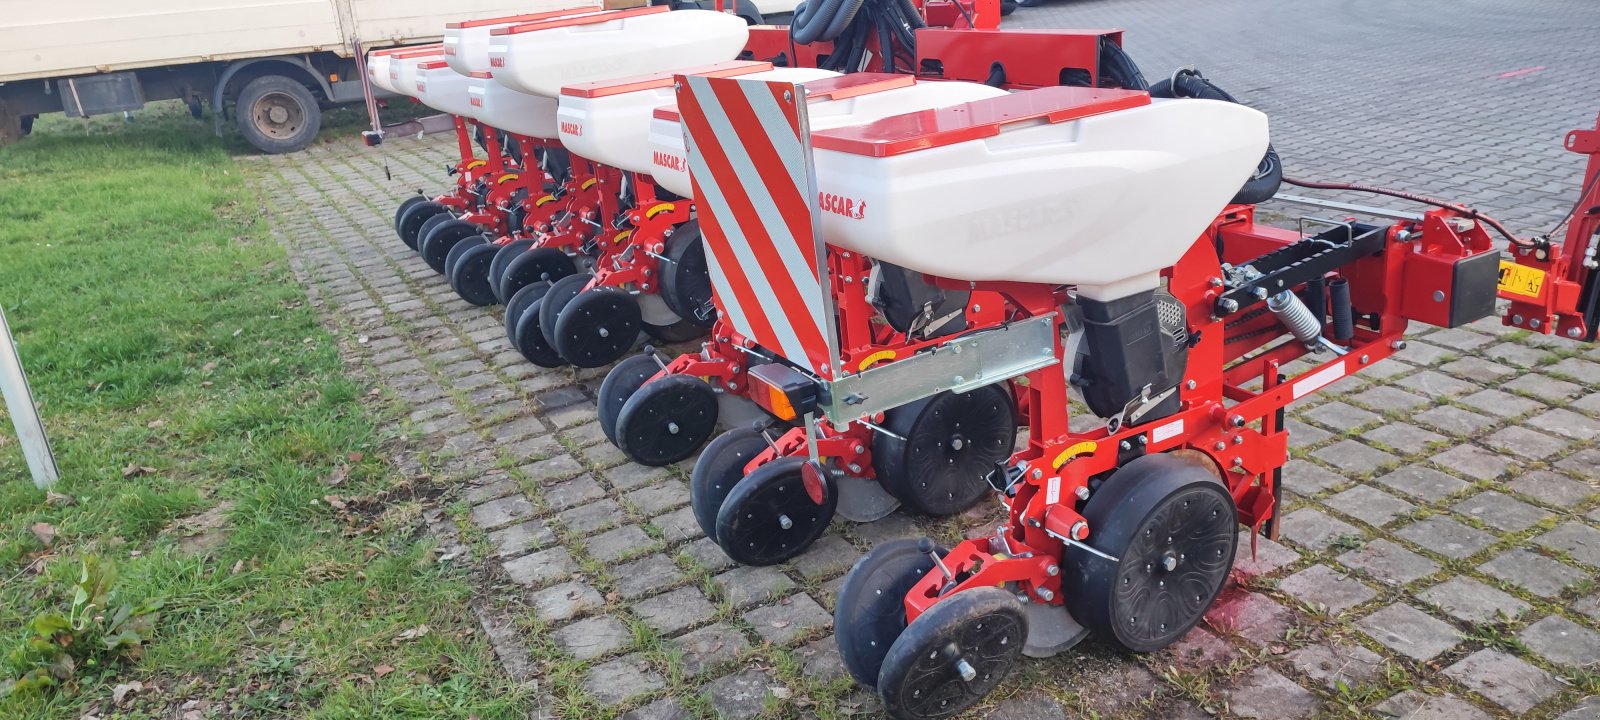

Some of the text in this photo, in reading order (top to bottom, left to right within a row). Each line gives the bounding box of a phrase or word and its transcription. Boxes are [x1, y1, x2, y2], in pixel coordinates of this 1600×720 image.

[561, 121, 578, 136] MASCAR
[653, 151, 680, 172] MASCAR
[818, 191, 853, 218] ASCAR
